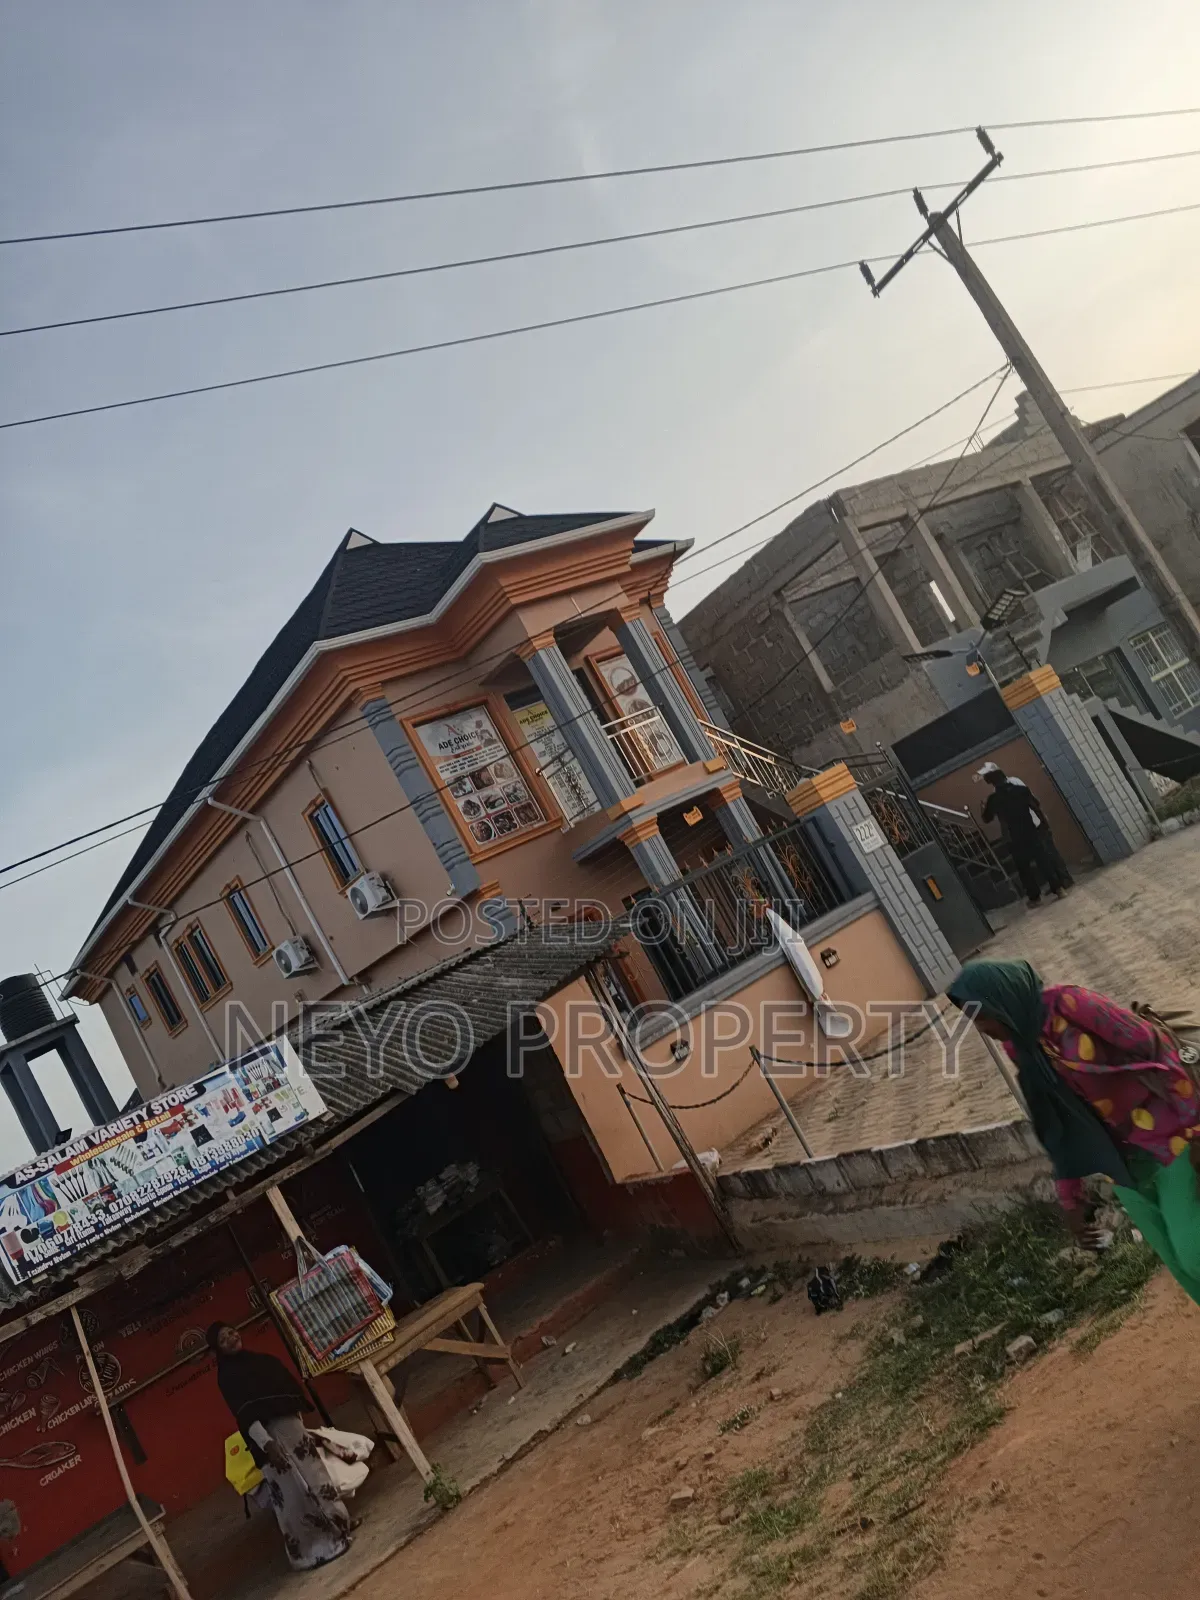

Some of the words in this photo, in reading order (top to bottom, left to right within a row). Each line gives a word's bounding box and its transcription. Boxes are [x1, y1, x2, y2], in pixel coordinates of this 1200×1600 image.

[437, 739, 453, 750] ADE
[15, 1140, 89, 1185] AS-SALAM
[89, 1107, 149, 1144] VARIETY
[150, 1084, 198, 1115] STORE
[134, 1123, 144, 1133] &
[143, 1109, 171, 1129] Retail
[100, 1205, 132, 1226] Takeaway
[135, 1190, 157, 1207] Plastic
[155, 1181, 174, 1196] Spoon
[47, 1404, 81, 1431] CHICKEN
[39, 1454, 83, 1487] CROAKER
